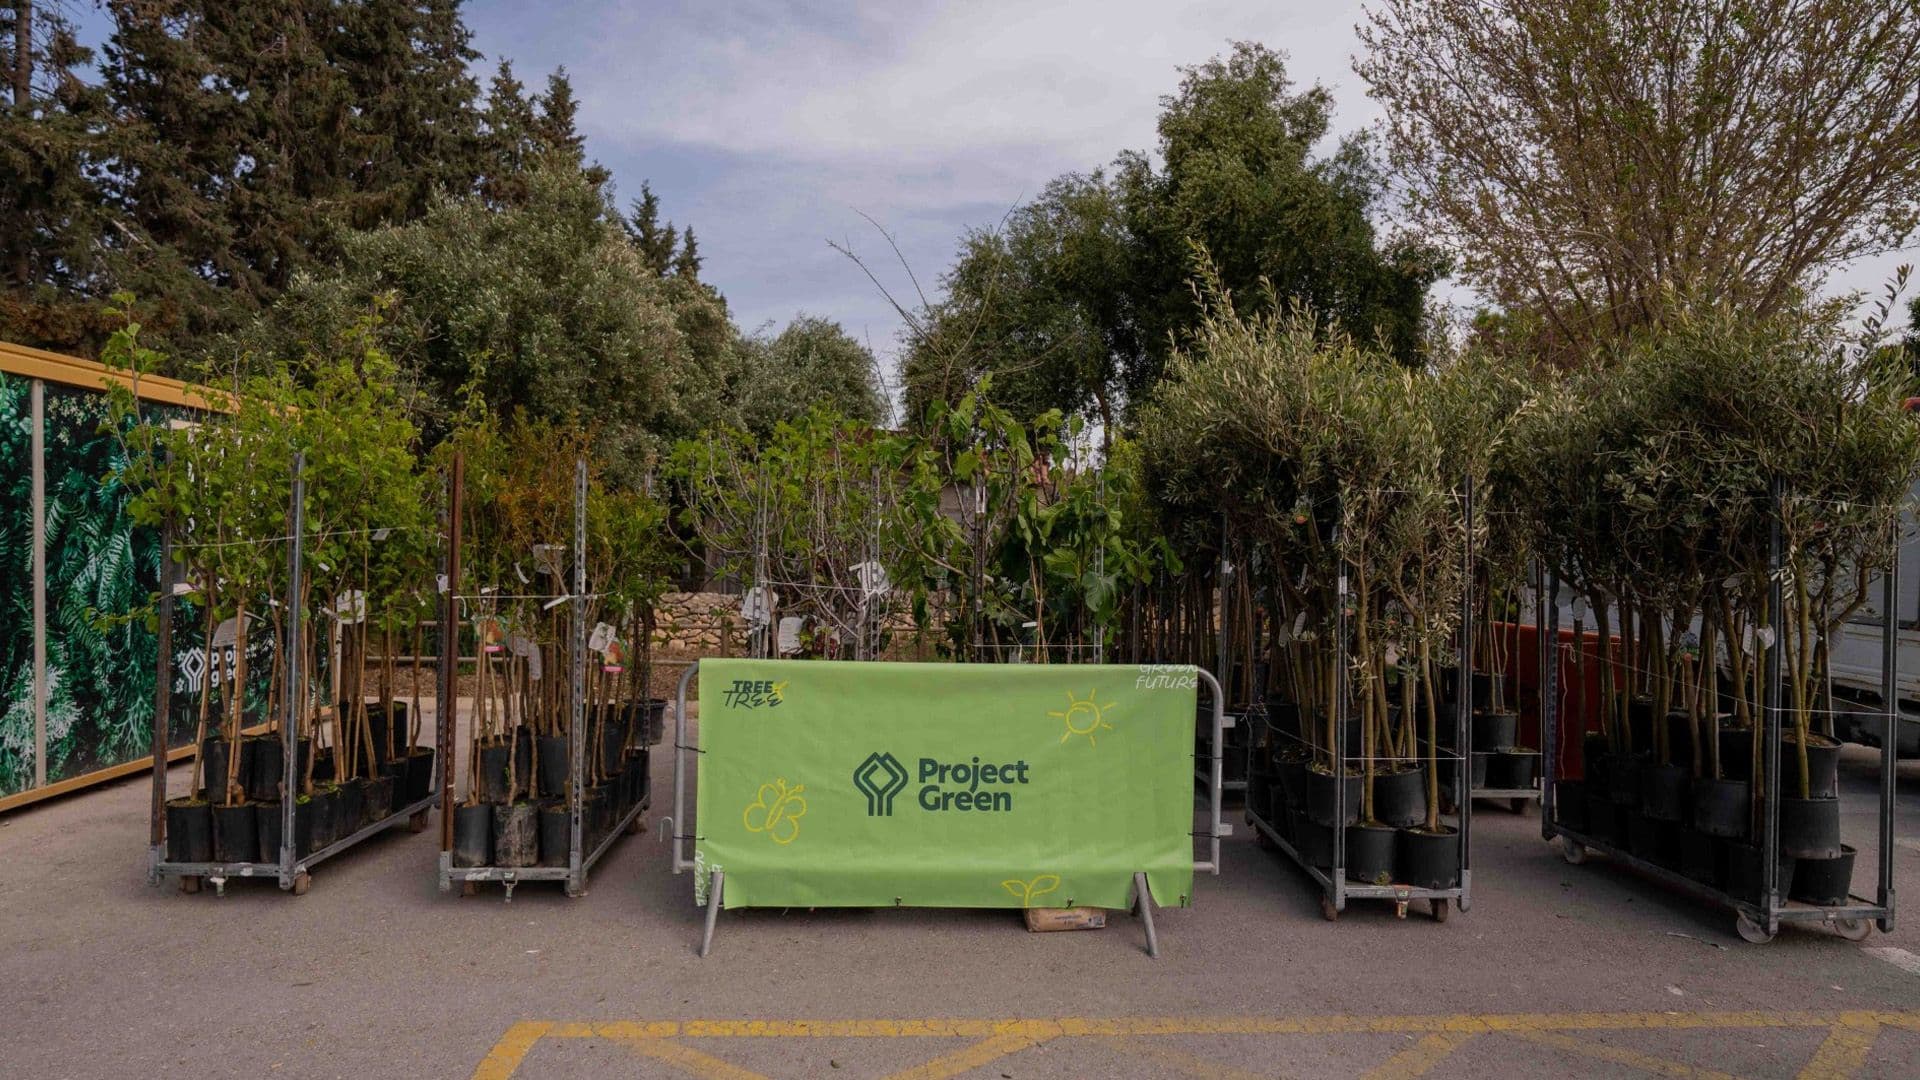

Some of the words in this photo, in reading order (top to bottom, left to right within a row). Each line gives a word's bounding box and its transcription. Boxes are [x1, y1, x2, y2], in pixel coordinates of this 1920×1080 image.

[732, 680, 774, 694] TREE
[1136, 675, 1198, 690] FUTURE
[722, 690, 783, 710] TREE
[918, 756, 1030, 794] Project
[918, 785, 1012, 812] Green
